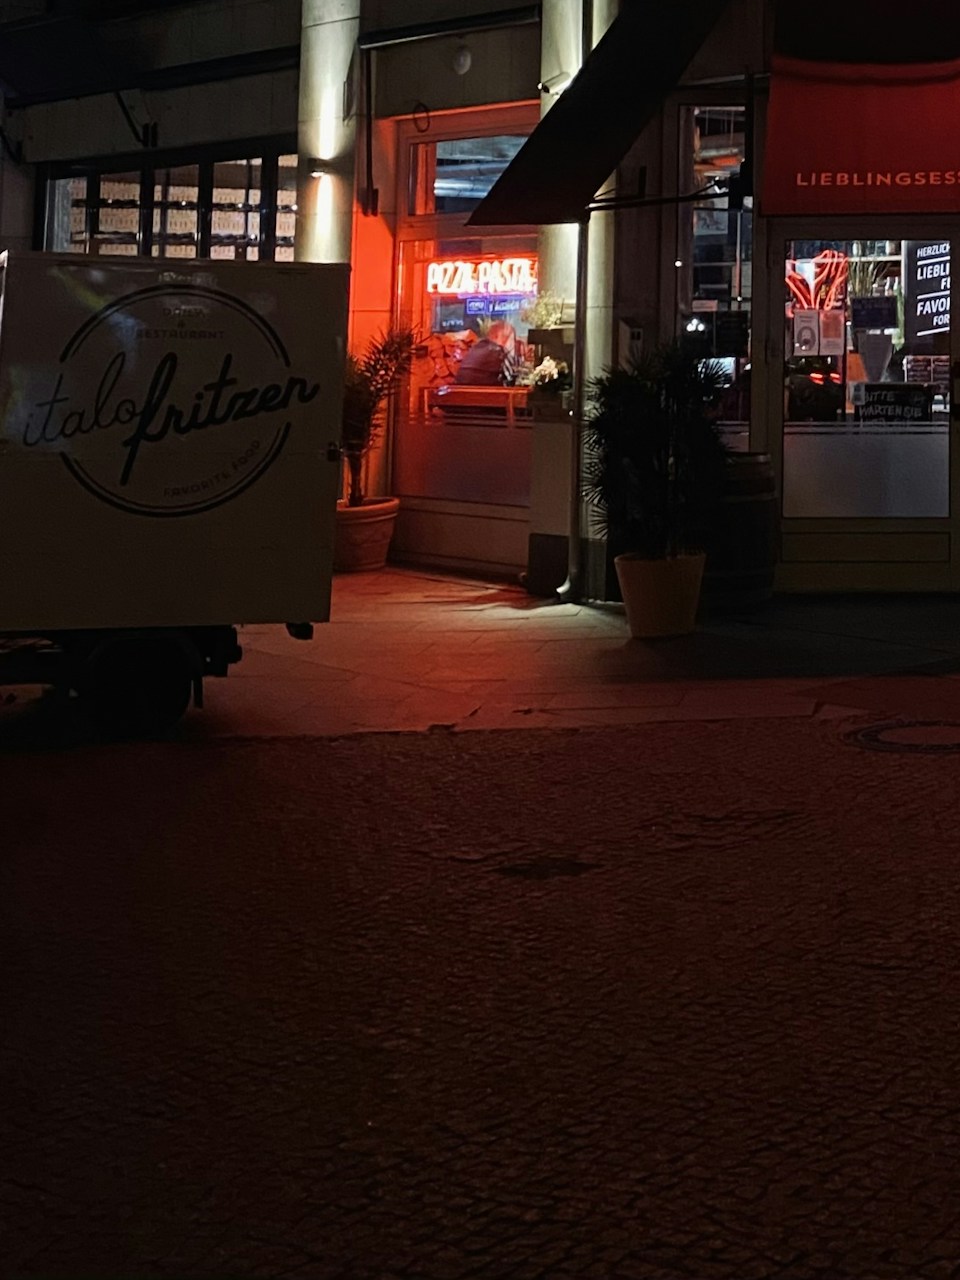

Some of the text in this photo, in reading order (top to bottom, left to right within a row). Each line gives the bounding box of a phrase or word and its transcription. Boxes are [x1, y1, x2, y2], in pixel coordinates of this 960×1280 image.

[137, 329, 224, 339] RESTAURANT
[163, 439, 260, 497] FAVORITE FOOD
